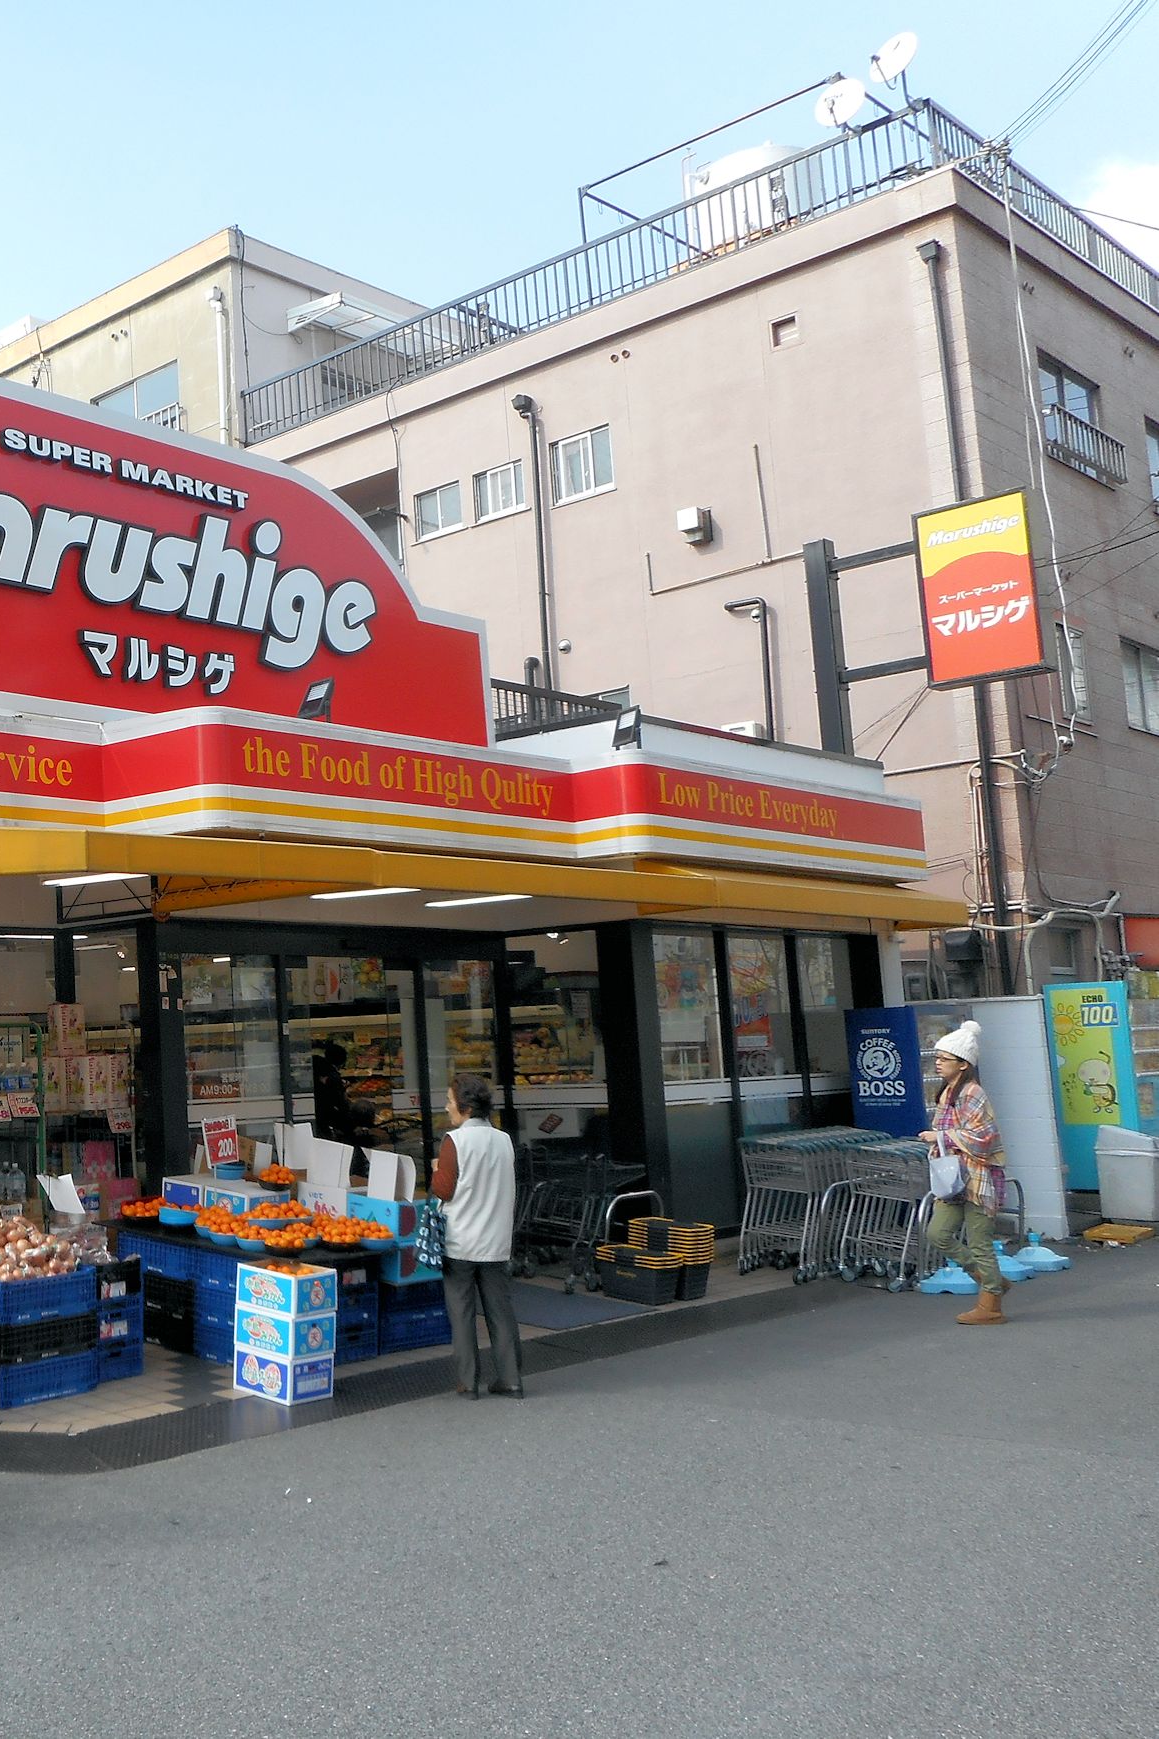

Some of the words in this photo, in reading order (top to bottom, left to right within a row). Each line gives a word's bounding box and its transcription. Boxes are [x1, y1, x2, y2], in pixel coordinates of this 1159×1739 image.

[2, 428, 112, 475] SUPER
[121, 461, 249, 509] MARKET
[926, 514, 1020, 548] Marushige
[939, 580, 1020, 605] スーパーマーケット
[932, 596, 1030, 637] マルシゲ
[79, 630, 236, 695] マルシゲ
[242, 736, 290, 777] the
[299, 743, 369, 786] Food
[379, 749, 406, 791] of
[413, 756, 475, 805] High
[480, 768, 555, 817] Qulity
[658, 772, 701, 807] Low
[707, 781, 754, 817] Price
[759, 789, 839, 837] Everyday
[859, 1037, 896, 1051] COFFEE
[857, 1080, 906, 1096] BOSS
